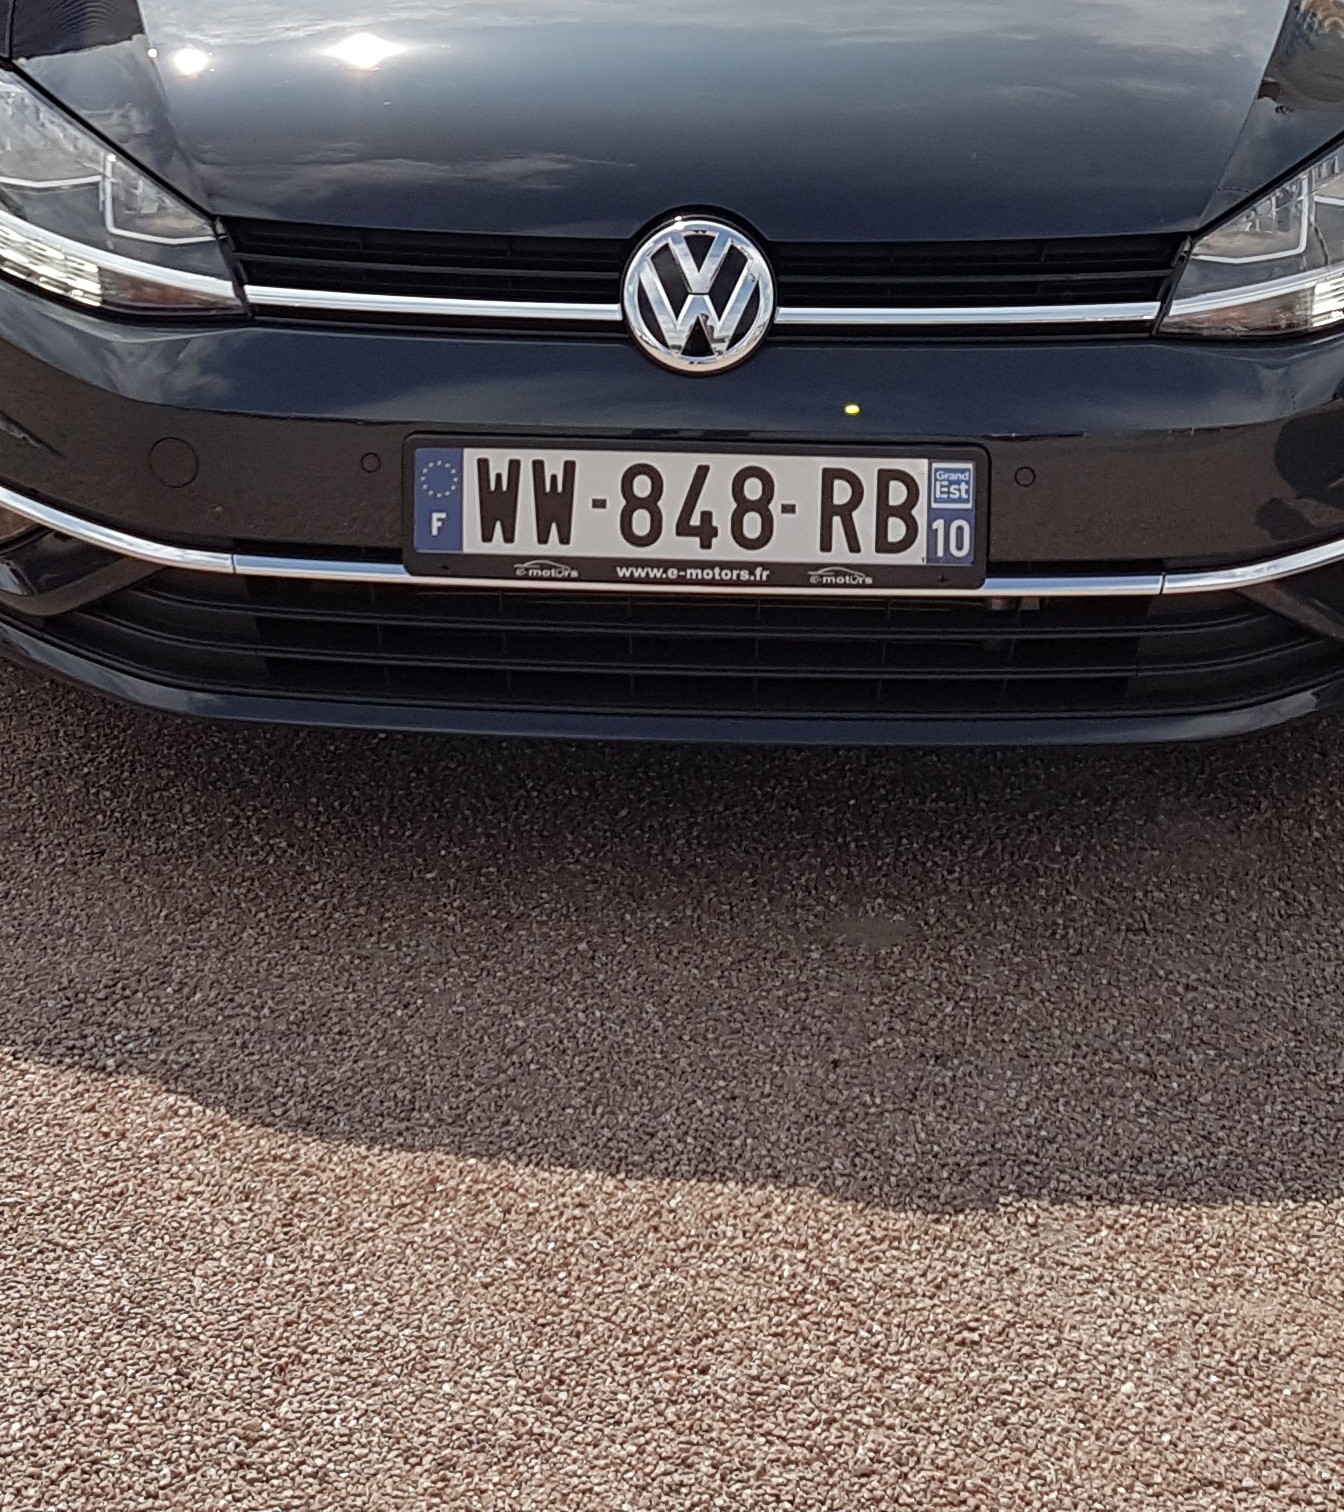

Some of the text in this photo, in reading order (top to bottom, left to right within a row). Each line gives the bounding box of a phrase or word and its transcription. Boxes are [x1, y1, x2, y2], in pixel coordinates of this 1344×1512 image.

[935, 470, 970, 481] Grand
[935, 481, 969, 500] Est
[475, 456, 921, 555] WW-848-RB
[431, 511, 447, 537] F
[931, 518, 971, 558] 10
[616, 564, 771, 582] www.e-motors.fr
